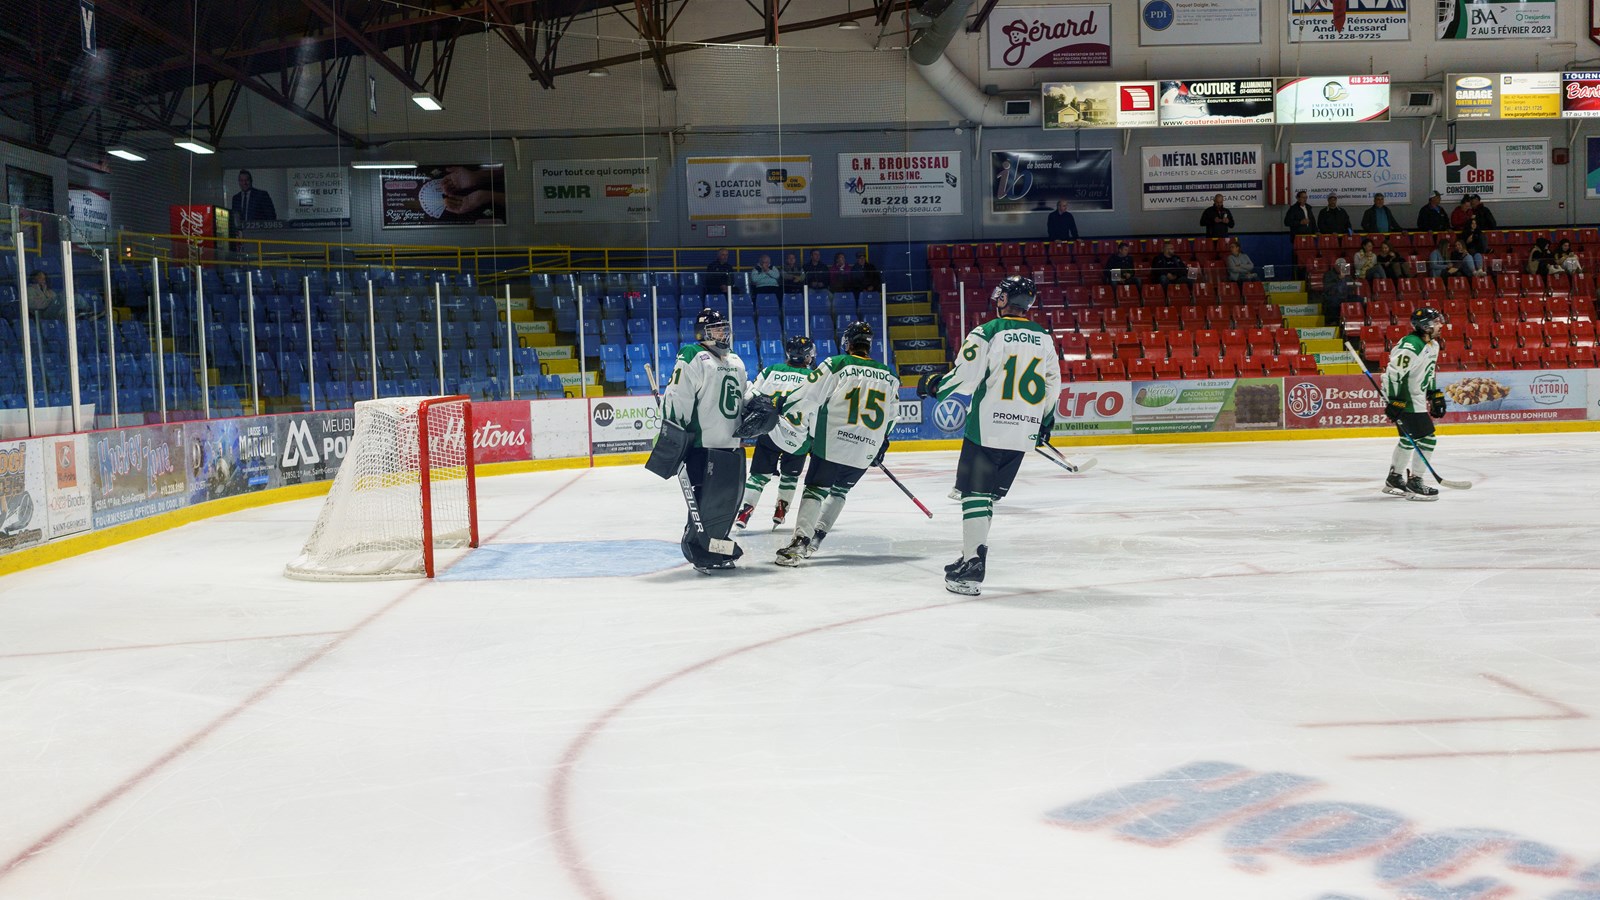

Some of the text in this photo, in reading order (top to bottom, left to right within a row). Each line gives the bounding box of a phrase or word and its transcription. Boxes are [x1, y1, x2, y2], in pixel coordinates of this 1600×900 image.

[1151, 10, 1167, 19] PDI
[1293, 18, 1328, 26] Centre
[1347, 16, 1406, 24] Rénovation
[1348, 24, 1387, 32] Lessard
[1471, 27, 1477, 35] 2
[1478, 27, 1489, 35] AU
[1498, 25, 1530, 34] FÉVRIER
[1531, 25, 1552, 34] 2023
[1002, 10, 1097, 66] Gérard
[1240, 81, 1272, 89] ALUMINIUM
[1351, 76, 1361, 84] 418
[1190, 82, 1237, 95] COUTURE
[1455, 90, 1493, 100] GARAGE
[1163, 117, 1272, 126] www.couturealuminium.com
[851, 156, 949, 171] G.H. BROUSSEAU
[1162, 151, 1256, 167] MÉTAL SARTIGAN
[1316, 149, 1392, 169] ESSOR
[542, 168, 564, 177] Pour
[564, 168, 583, 176] tout
[596, 168, 611, 177] qui
[880, 171, 923, 181] & FILS INC.
[1316, 170, 1372, 180] ASSURANCES
[1467, 169, 1495, 183] CRB
[715, 180, 761, 188] LOCATION
[543, 185, 591, 199] BMR
[722, 189, 761, 198] BEAUCE
[1446, 185, 1494, 194] CONSTRUCTION
[861, 195, 942, 205] 418-228 3212
[1150, 194, 1257, 204] WWW.METALSARGAN.COM
[861, 205, 942, 216] www.ghbrousseau.ca
[1004, 333, 1041, 346] GAGNE
[1397, 353, 1411, 369] 18
[774, 374, 804, 383] POIRIE
[1001, 355, 1046, 406] 16
[1529, 383, 1569, 395] VICTORIA
[1058, 387, 1124, 417] tro
[1325, 401, 1341, 409] On
[1342, 401, 1367, 409] aime
[845, 386, 886, 431] 15
[594, 409, 615, 420] AUX
[1319, 414, 1388, 425] 418.228.82
[1466, 413, 1472, 421] À
[239, 434, 276, 460] MARQUE
[680, 478, 705, 533] BAUER
[95, 509, 134, 526] FOURNISSEUR
[134, 503, 157, 517] OFFICIEL
[158, 502, 165, 511] DU
[165, 499, 179, 510] COOL
